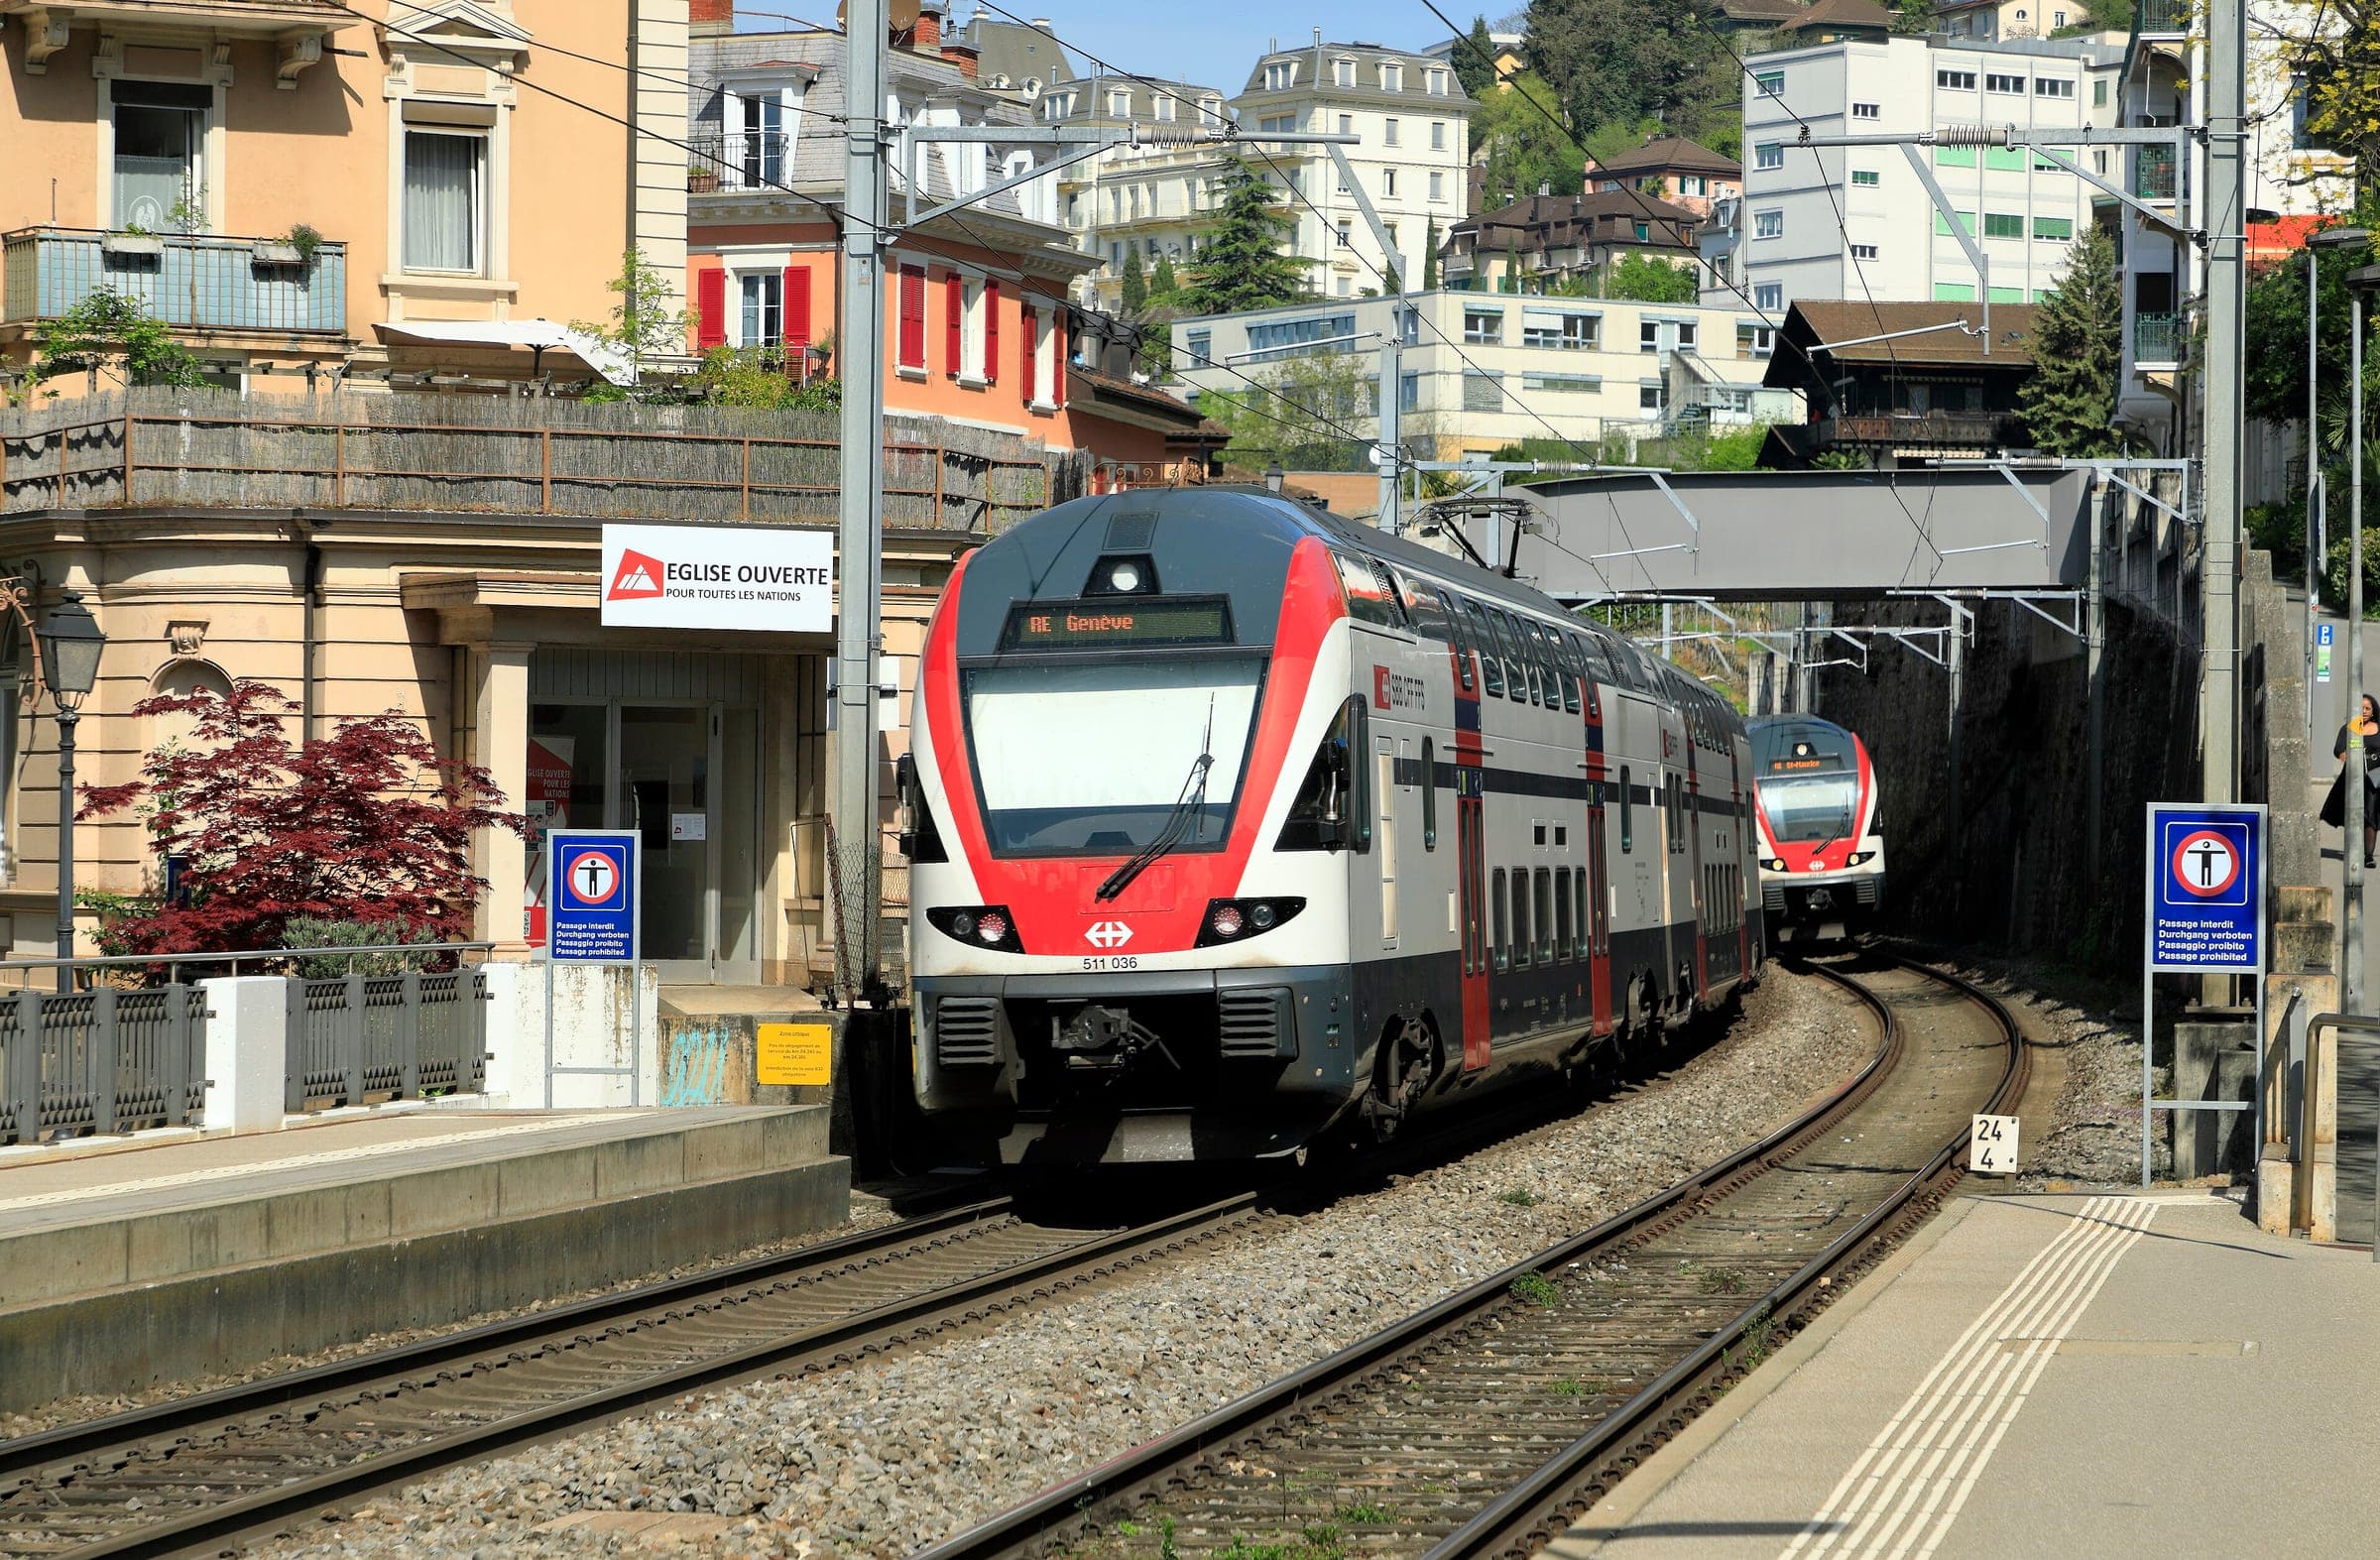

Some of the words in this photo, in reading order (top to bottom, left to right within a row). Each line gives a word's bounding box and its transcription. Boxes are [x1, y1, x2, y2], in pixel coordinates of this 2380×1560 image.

[667, 563, 731, 582] EGLISE
[738, 565, 828, 585] OUVERTE
[666, 589, 695, 598] POUR
[698, 590, 735, 600] TOUTES
[738, 590, 754, 600] LES
[757, 591, 801, 601] NATIONS
[1030, 616, 1052, 632] RE
[1066, 614, 1133, 632] Genève
[1392, 674, 1403, 706] SBB
[1415, 679, 1425, 711] FFS
[2159, 919, 2198, 929] Passage
[2159, 930, 2209, 940] Durchgang
[2159, 941, 2206, 951] Passaggio
[2209, 942, 2245, 951] proibito
[2159, 952, 2198, 961] Passage
[1083, 958, 1105, 969] 511
[1112, 957, 1137, 968] 036
[1978, 1120, 2002, 1141] 24
[1981, 1148, 1994, 1169] 4
